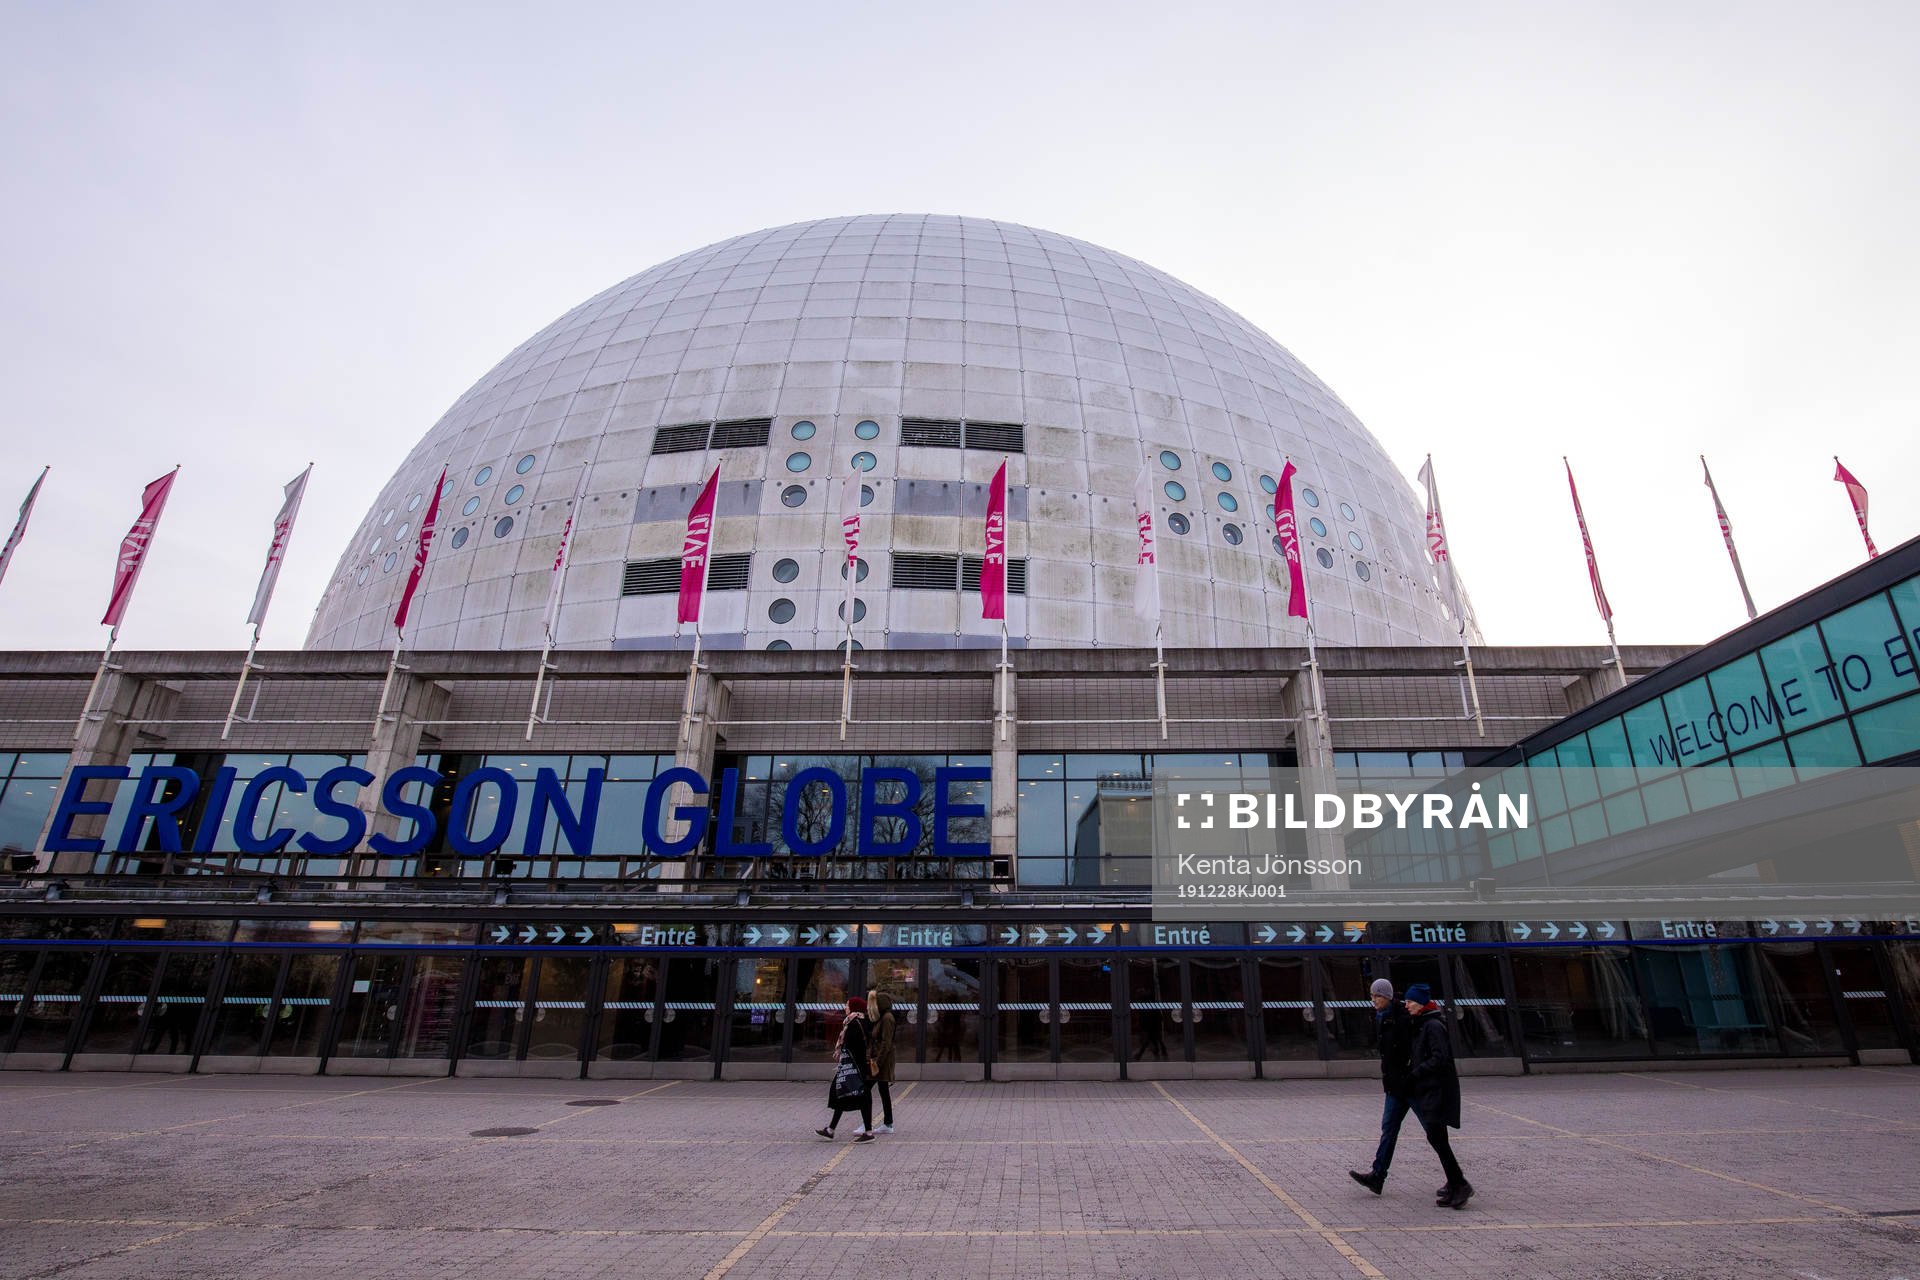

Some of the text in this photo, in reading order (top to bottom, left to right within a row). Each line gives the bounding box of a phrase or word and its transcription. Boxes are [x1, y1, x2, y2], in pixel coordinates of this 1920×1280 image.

[1649, 678, 1807, 766] WELCOME
[1814, 654, 1872, 701] TO
[43, 765, 992, 857] ERICSSON GLOBE
[641, 926, 696, 946] Entré
[897, 927, 953, 947] Entré
[1154, 925, 1210, 945] Entré
[1411, 924, 1466, 943] Entré
[1661, 918, 1717, 938] Entré
